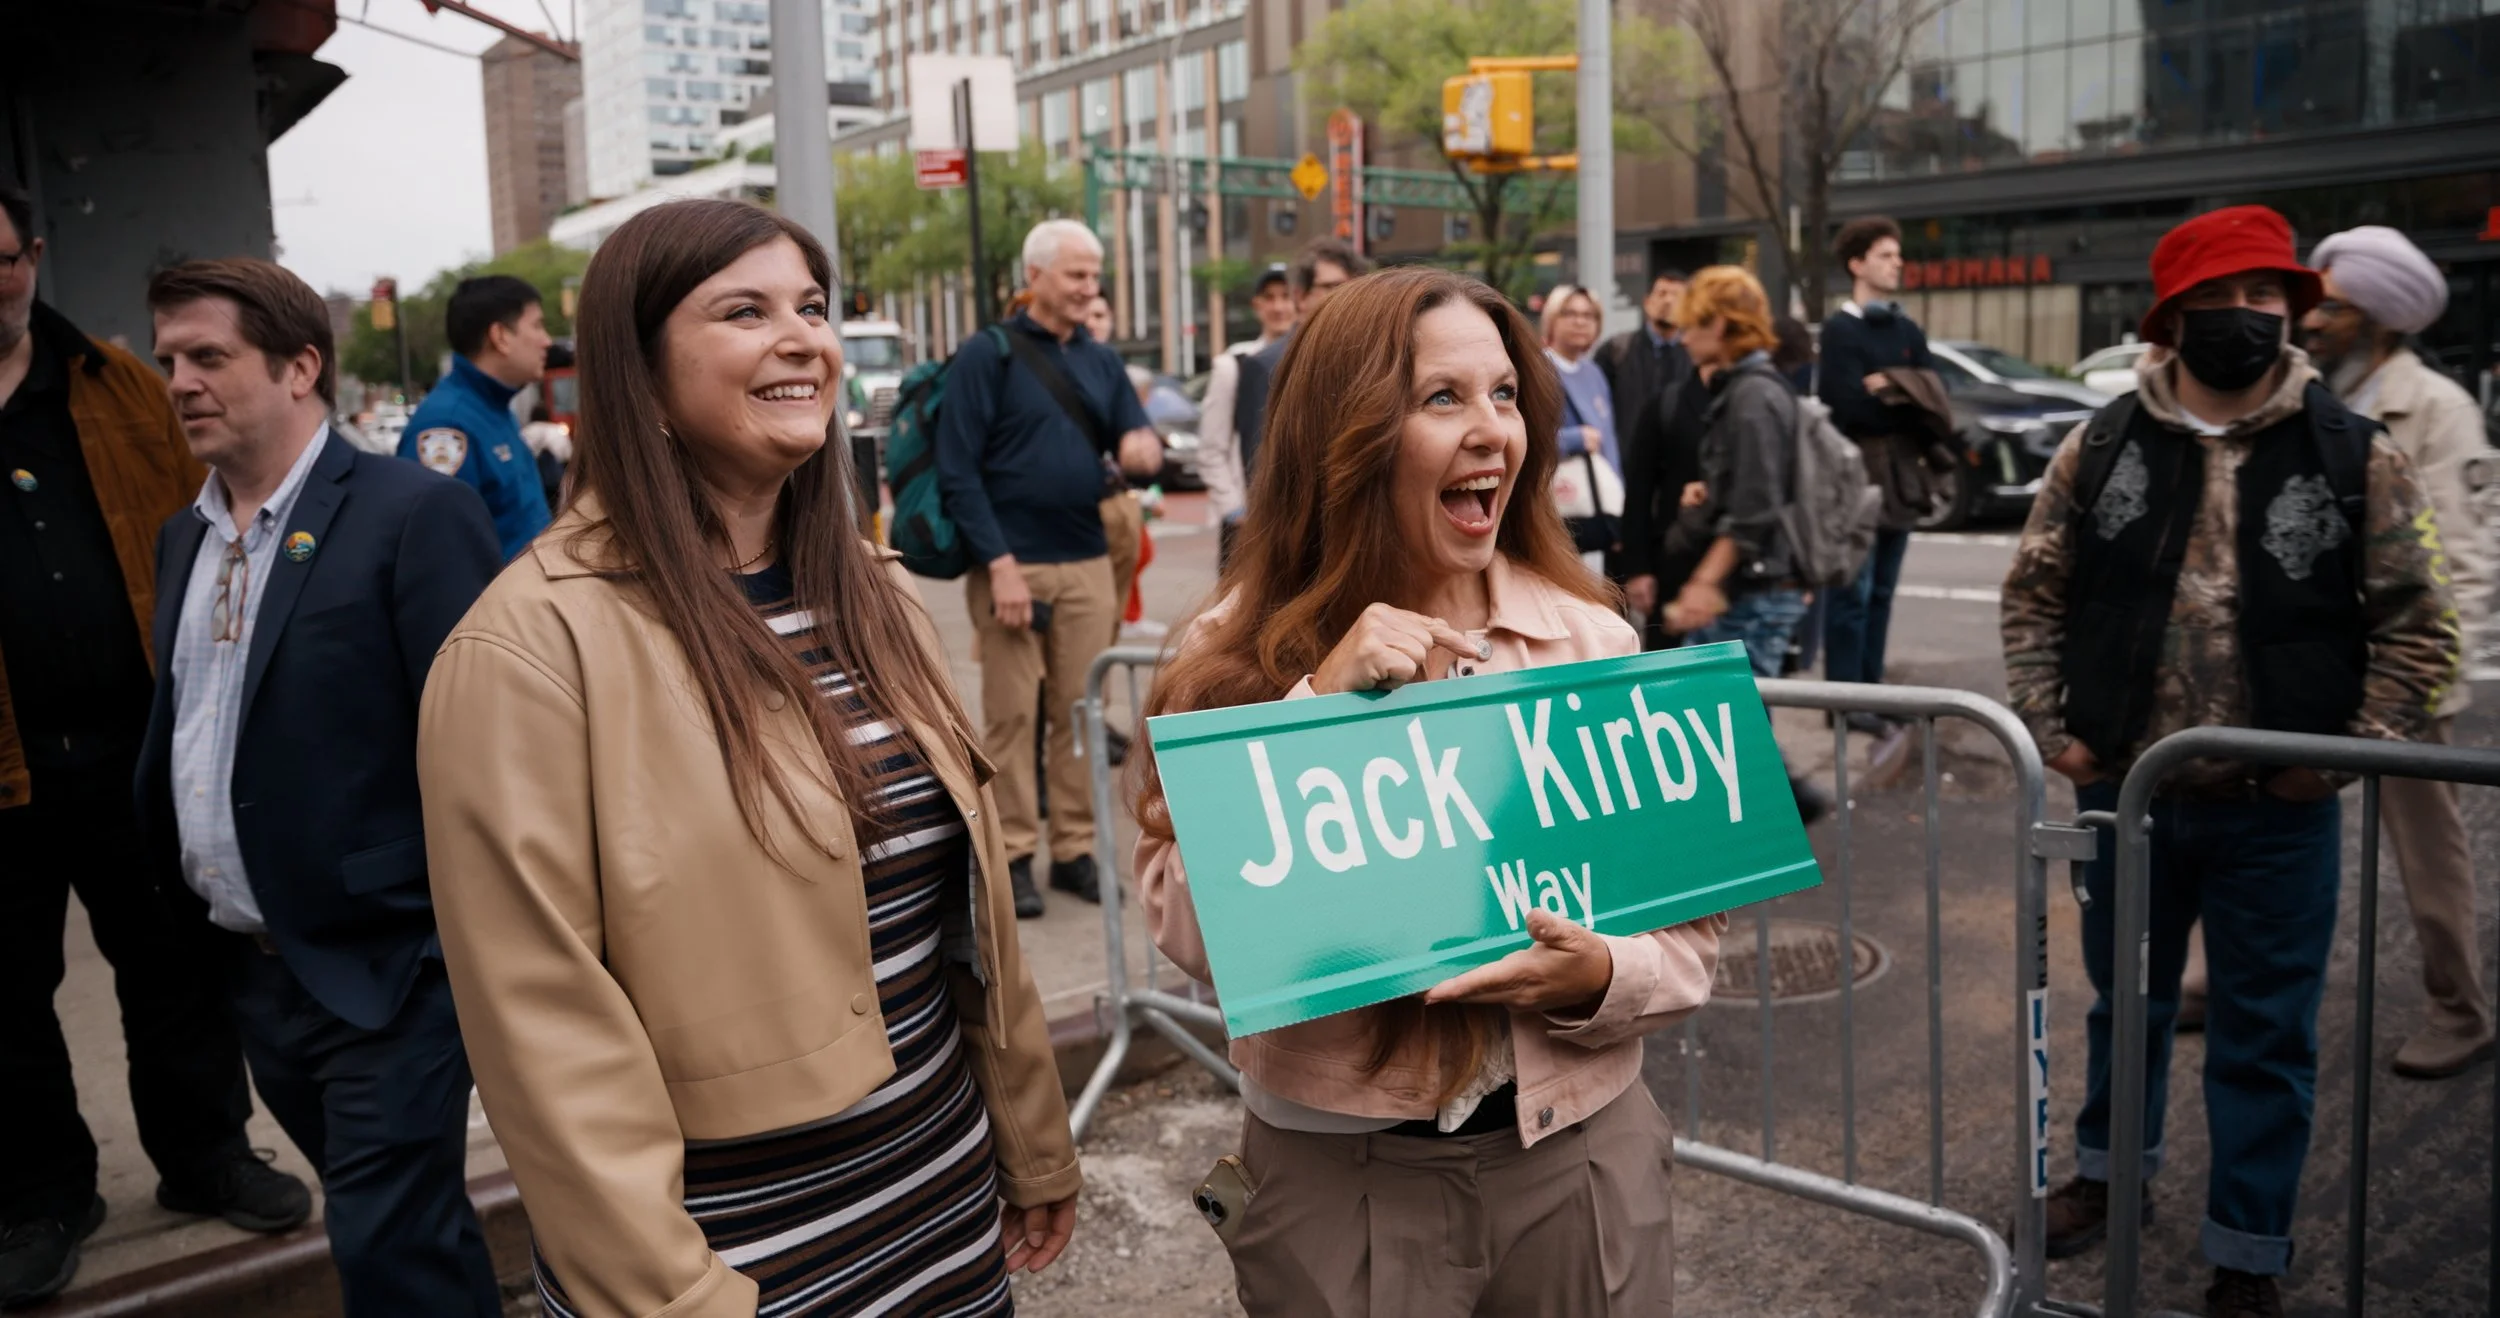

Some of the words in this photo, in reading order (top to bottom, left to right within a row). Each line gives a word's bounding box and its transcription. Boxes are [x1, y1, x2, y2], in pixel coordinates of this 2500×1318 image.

[1239, 716, 1495, 888] Jack
[1504, 683, 1743, 829] Kirby
[1485, 858, 1595, 931] Way
